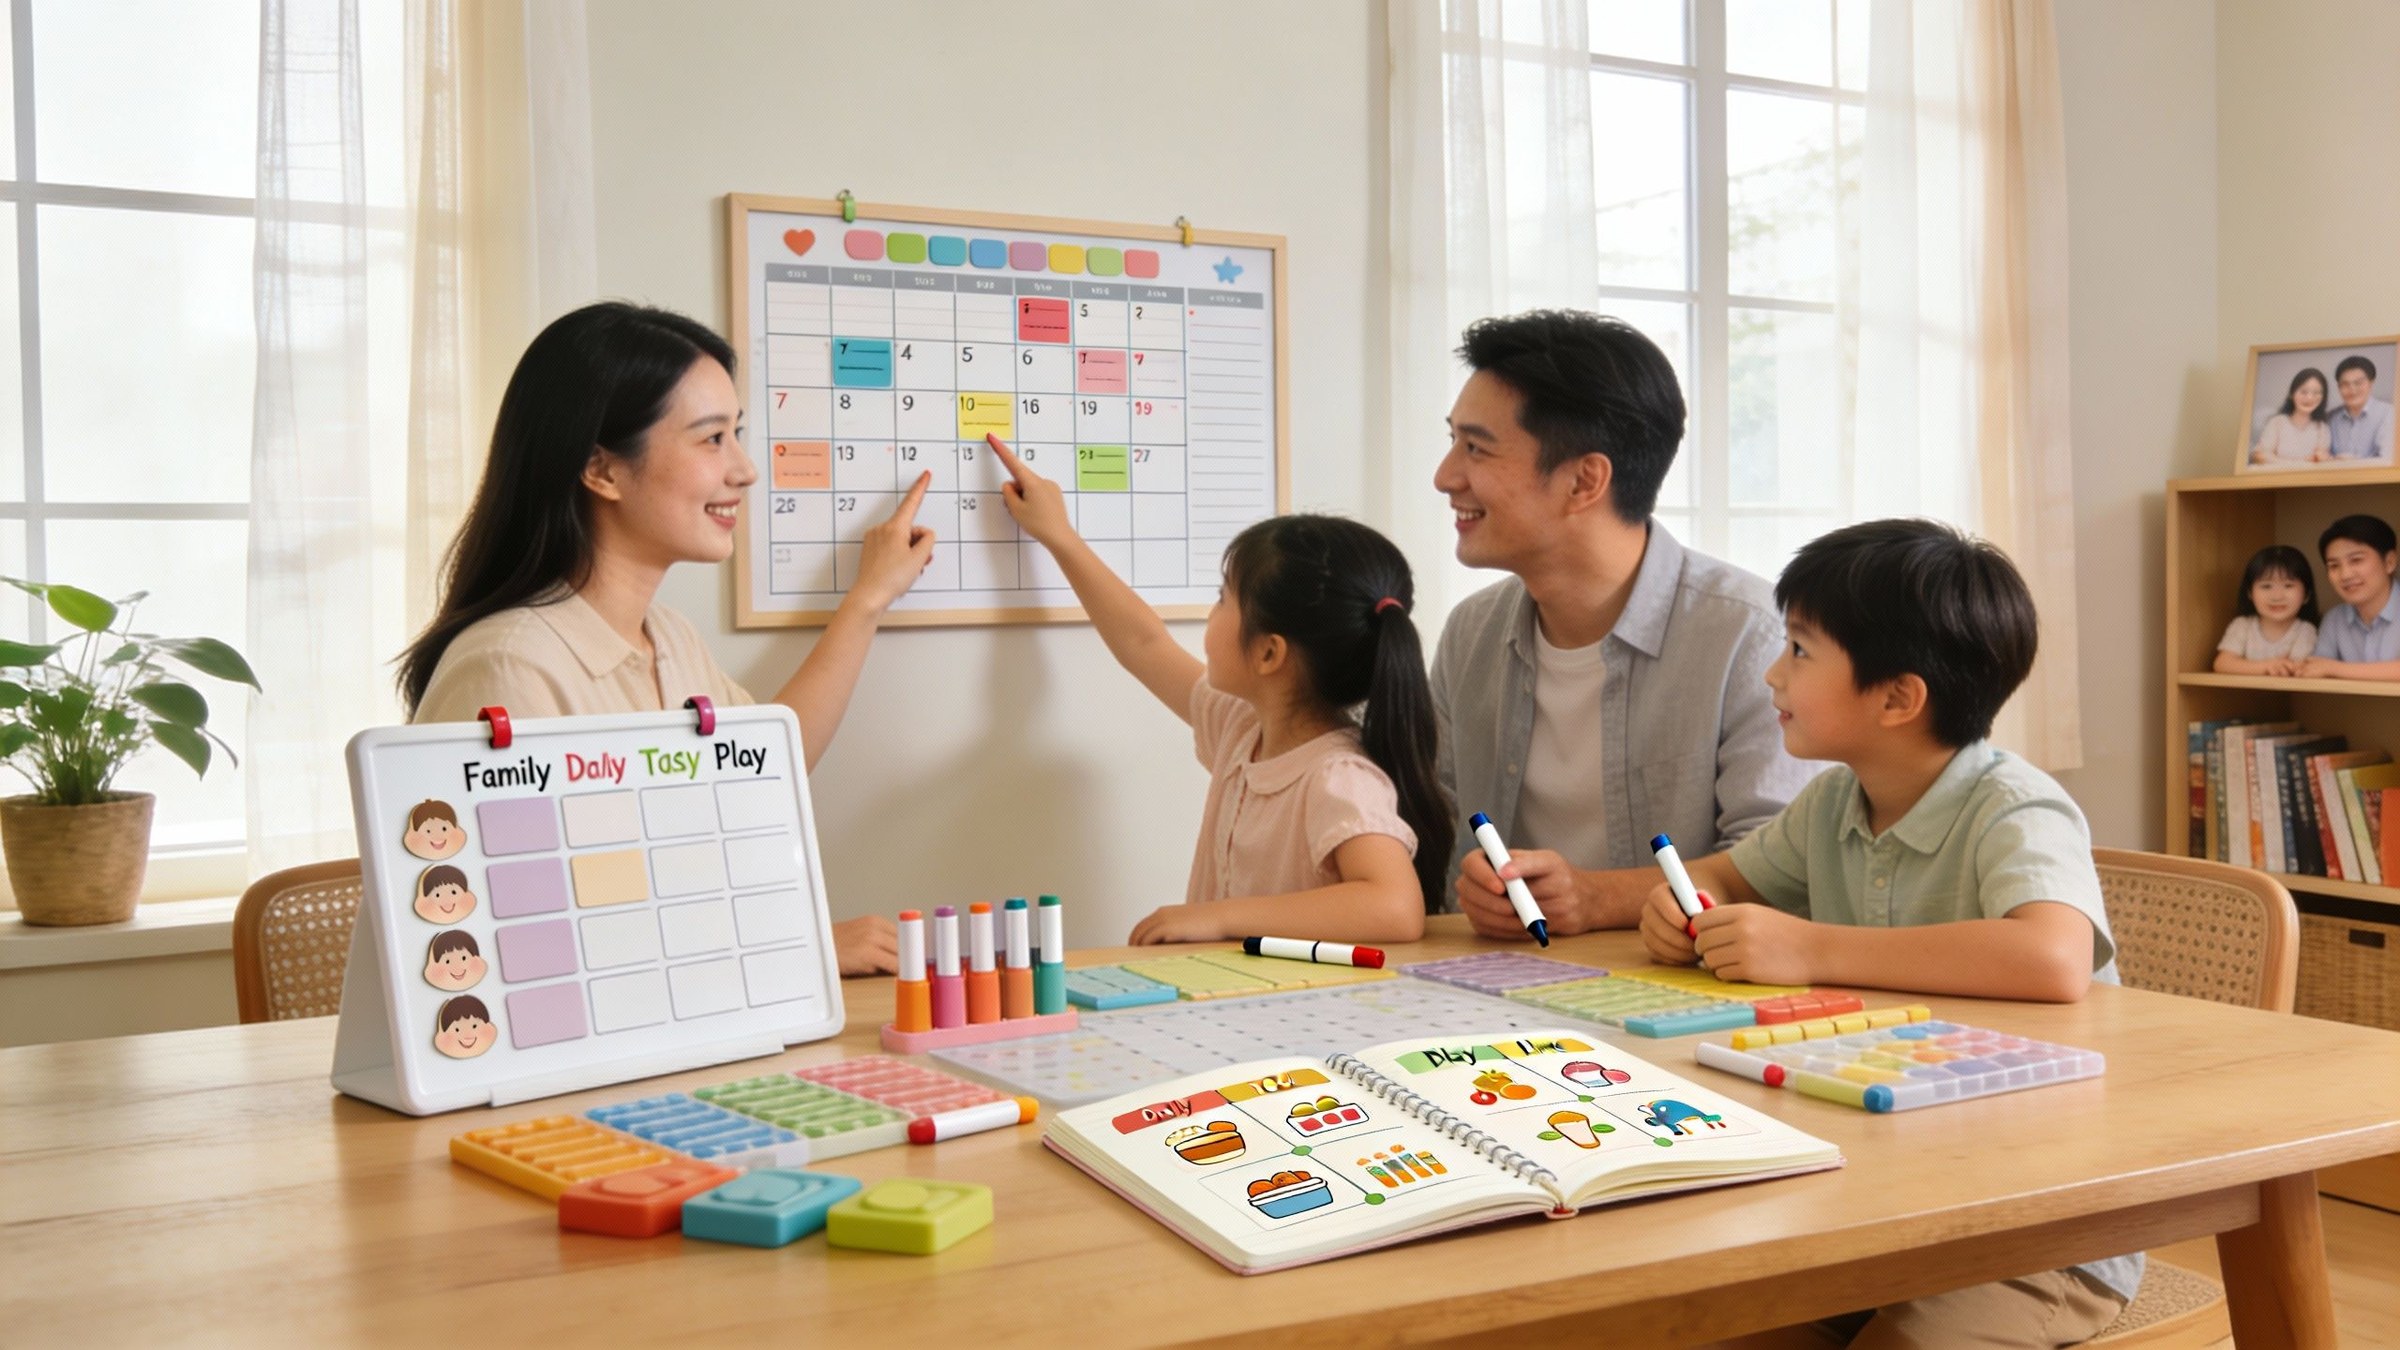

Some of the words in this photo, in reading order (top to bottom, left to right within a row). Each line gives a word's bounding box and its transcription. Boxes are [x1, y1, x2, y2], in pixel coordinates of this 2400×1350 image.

[901, 343, 913, 361] 4
[962, 346, 974, 362] 5
[1022, 349, 1033, 365] 6
[775, 392, 788, 409] 7
[839, 394, 851, 410] 8
[902, 395, 914, 411] 9
[959, 395, 975, 411] 10
[1022, 399, 1040, 415] 16
[1081, 400, 1097, 415] 19
[463, 755, 551, 792] Family
[714, 739, 767, 775] Play
